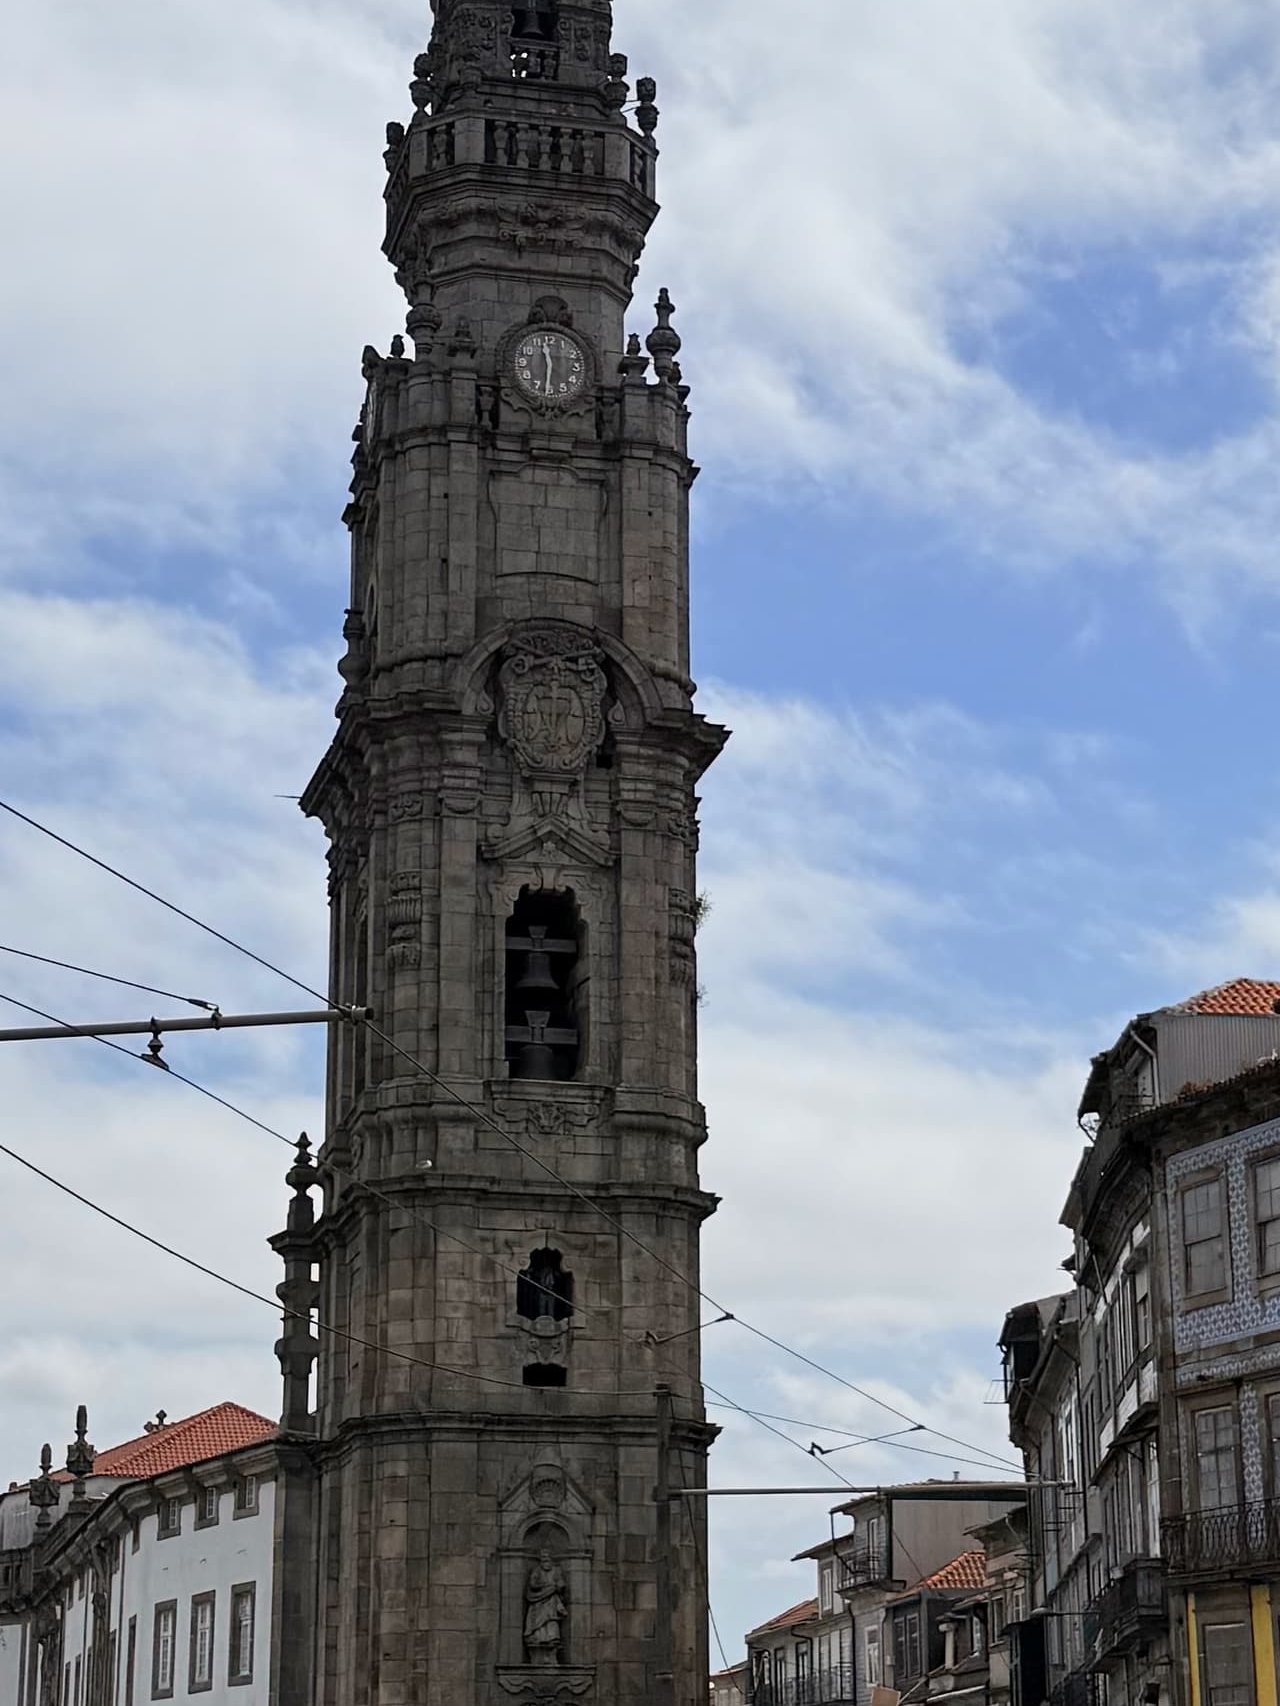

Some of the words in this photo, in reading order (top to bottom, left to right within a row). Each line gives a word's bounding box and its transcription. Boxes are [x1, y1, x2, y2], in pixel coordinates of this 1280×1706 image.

[533, 338, 541, 346] 11
[545, 336, 555, 344] 12
[523, 346, 533, 355] 10
[569, 349, 577, 359] 2
[519, 358, 527, 367] 9
[572, 363, 580, 372] 3
[523, 370, 531, 379] 8
[568, 375, 577, 383] 4
[534, 380, 541, 389] 7
[559, 383, 567, 392] 5
